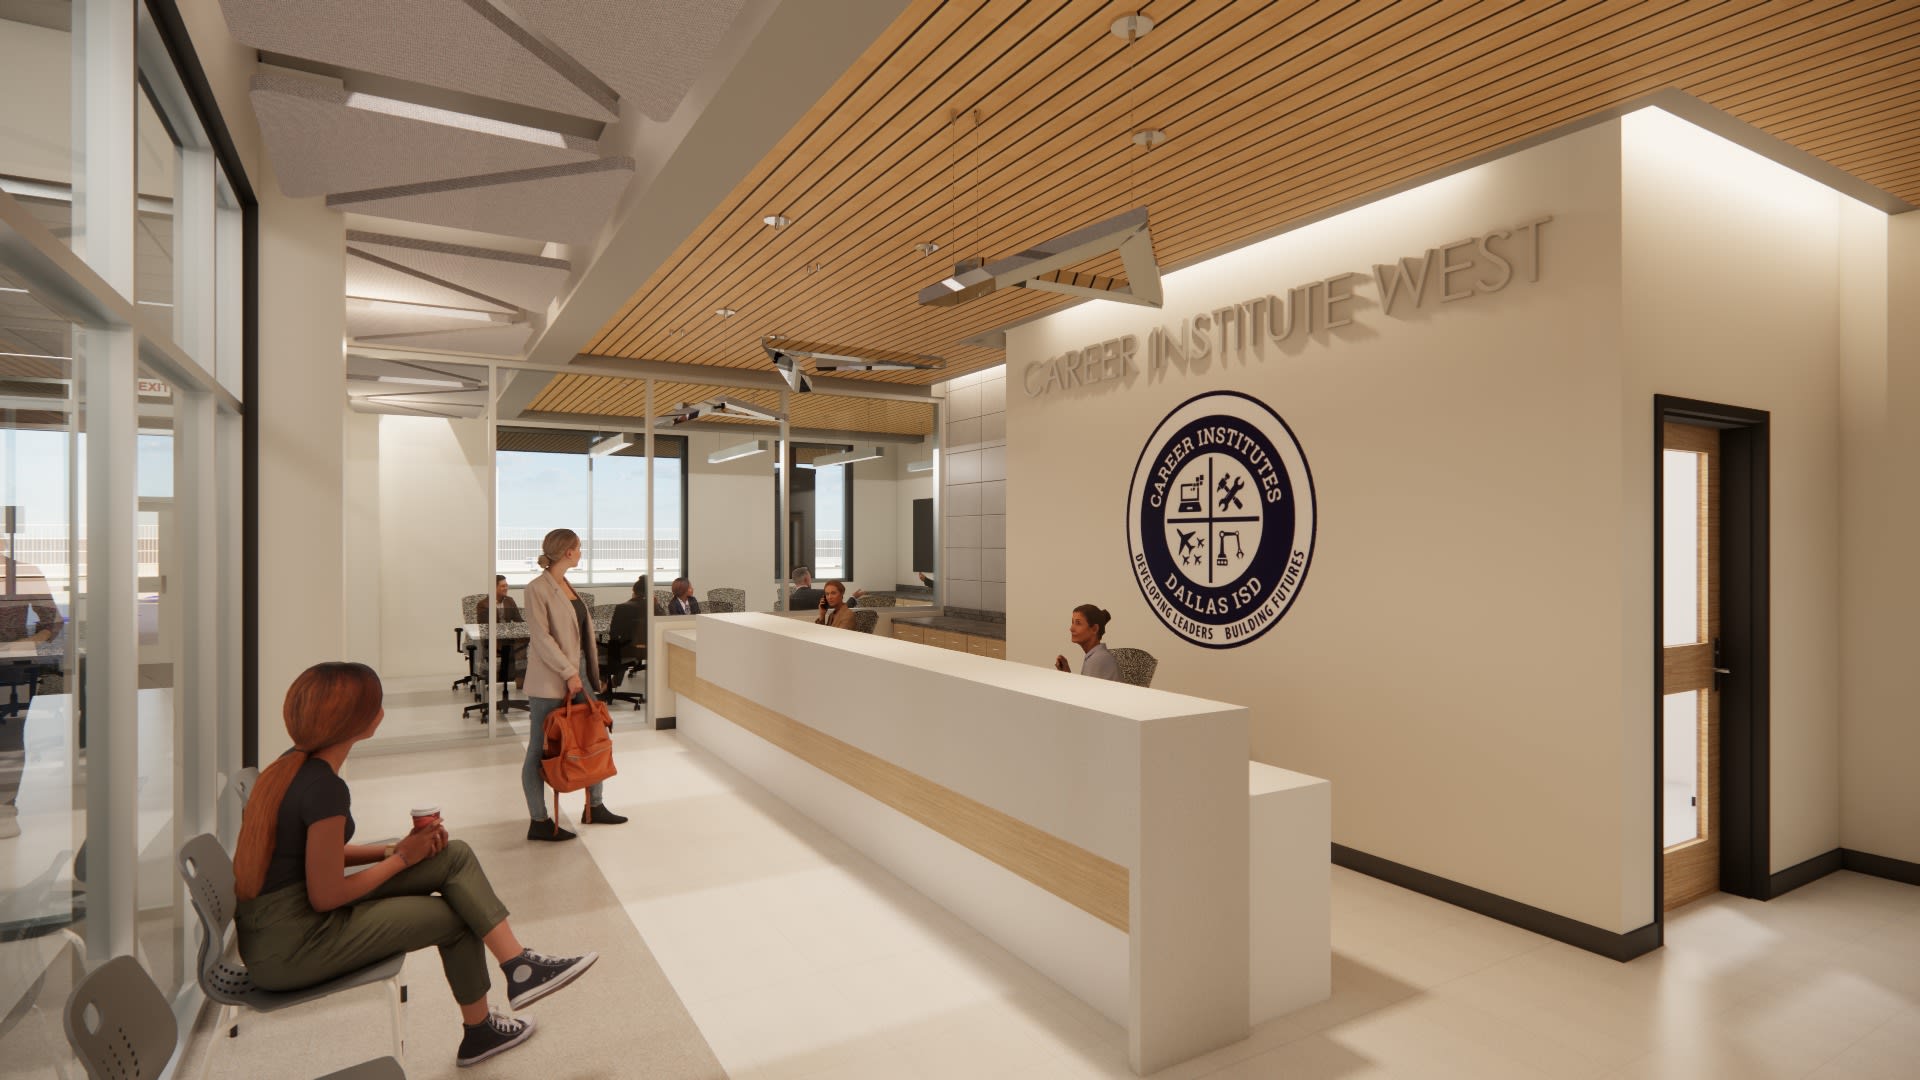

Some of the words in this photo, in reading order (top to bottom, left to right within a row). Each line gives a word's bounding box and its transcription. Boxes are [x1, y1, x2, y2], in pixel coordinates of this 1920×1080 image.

[1024, 334, 1138, 397] CAREER
[1149, 271, 1355, 370] INSTITUTE
[1374, 216, 1553, 315] WEST
[138, 381, 168, 393] EXIT
[1150, 436, 1195, 508] CAREER
[1196, 426, 1282, 504] INSTITUTES
[1135, 553, 1171, 619] DEVELOPING
[1172, 613, 1213, 640] LEADERS
[1225, 605, 1273, 640] BUILDING
[1274, 550, 1305, 609] FUTURES
[1164, 573, 1229, 615] DALLAS
[1233, 577, 1262, 610] ISD
